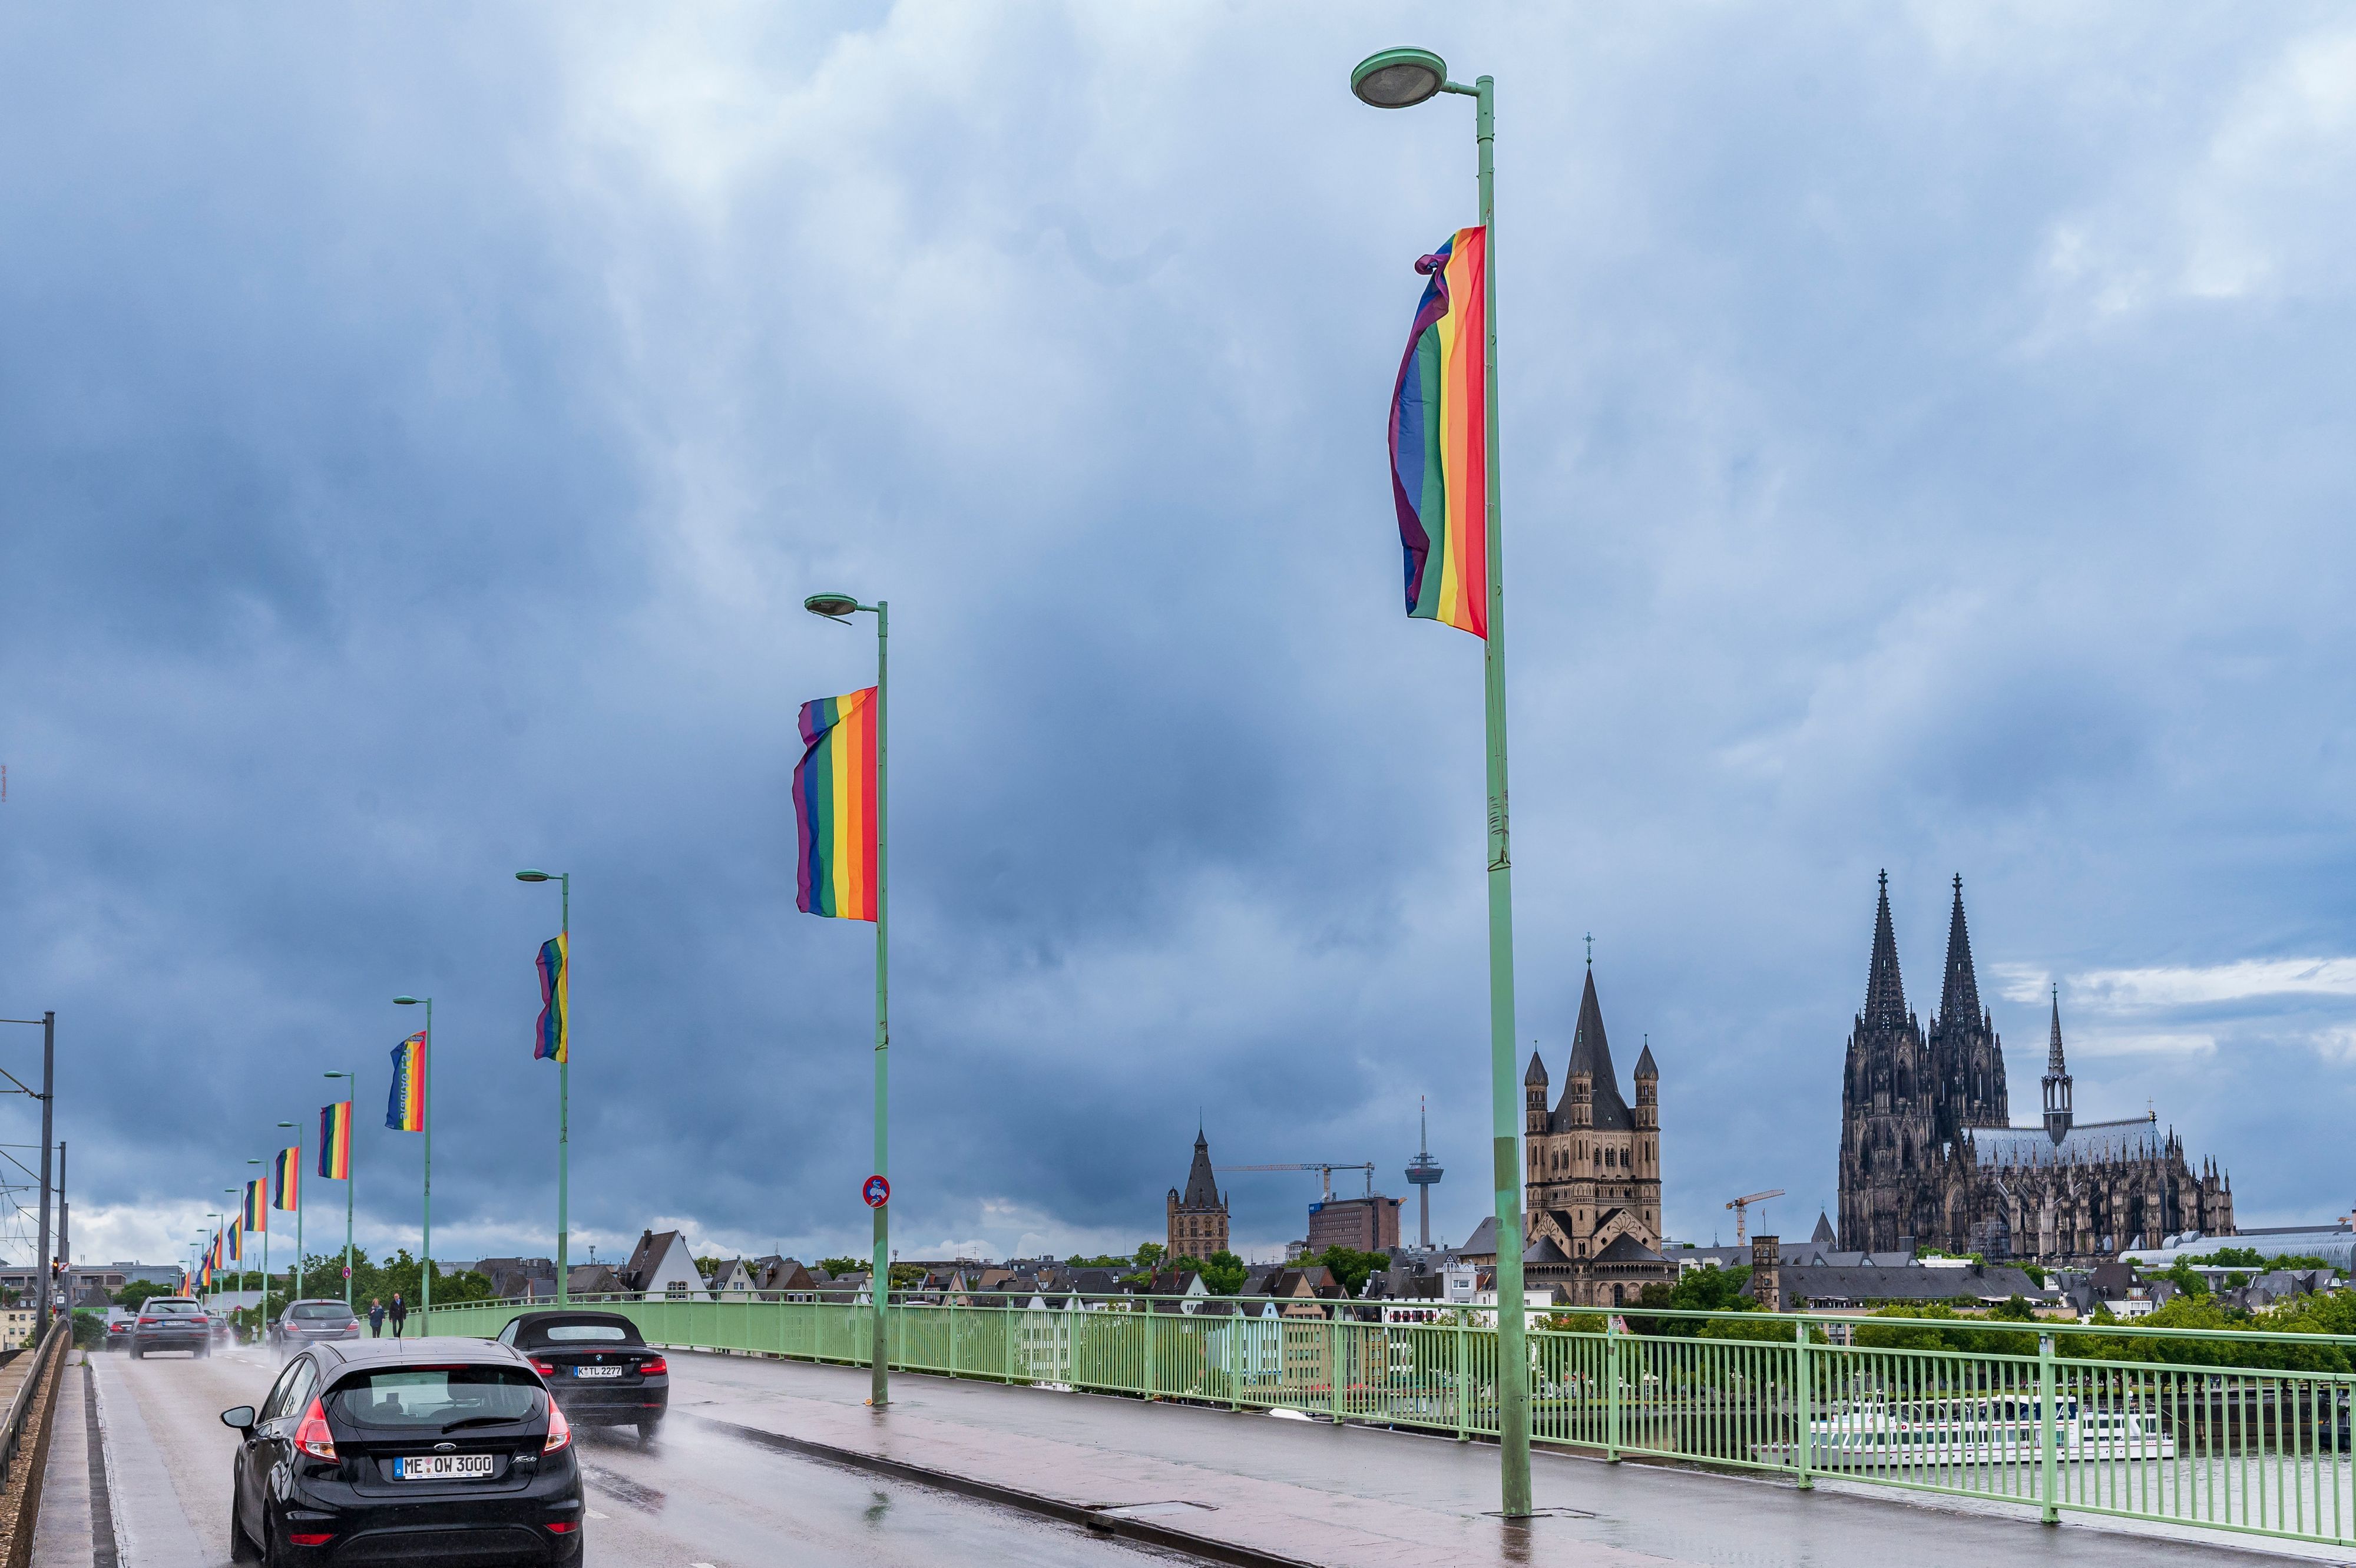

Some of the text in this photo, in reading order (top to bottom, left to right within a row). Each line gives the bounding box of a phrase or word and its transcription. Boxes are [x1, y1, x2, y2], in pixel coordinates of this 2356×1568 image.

[405, 1457, 491, 1474] ME OW 3000
